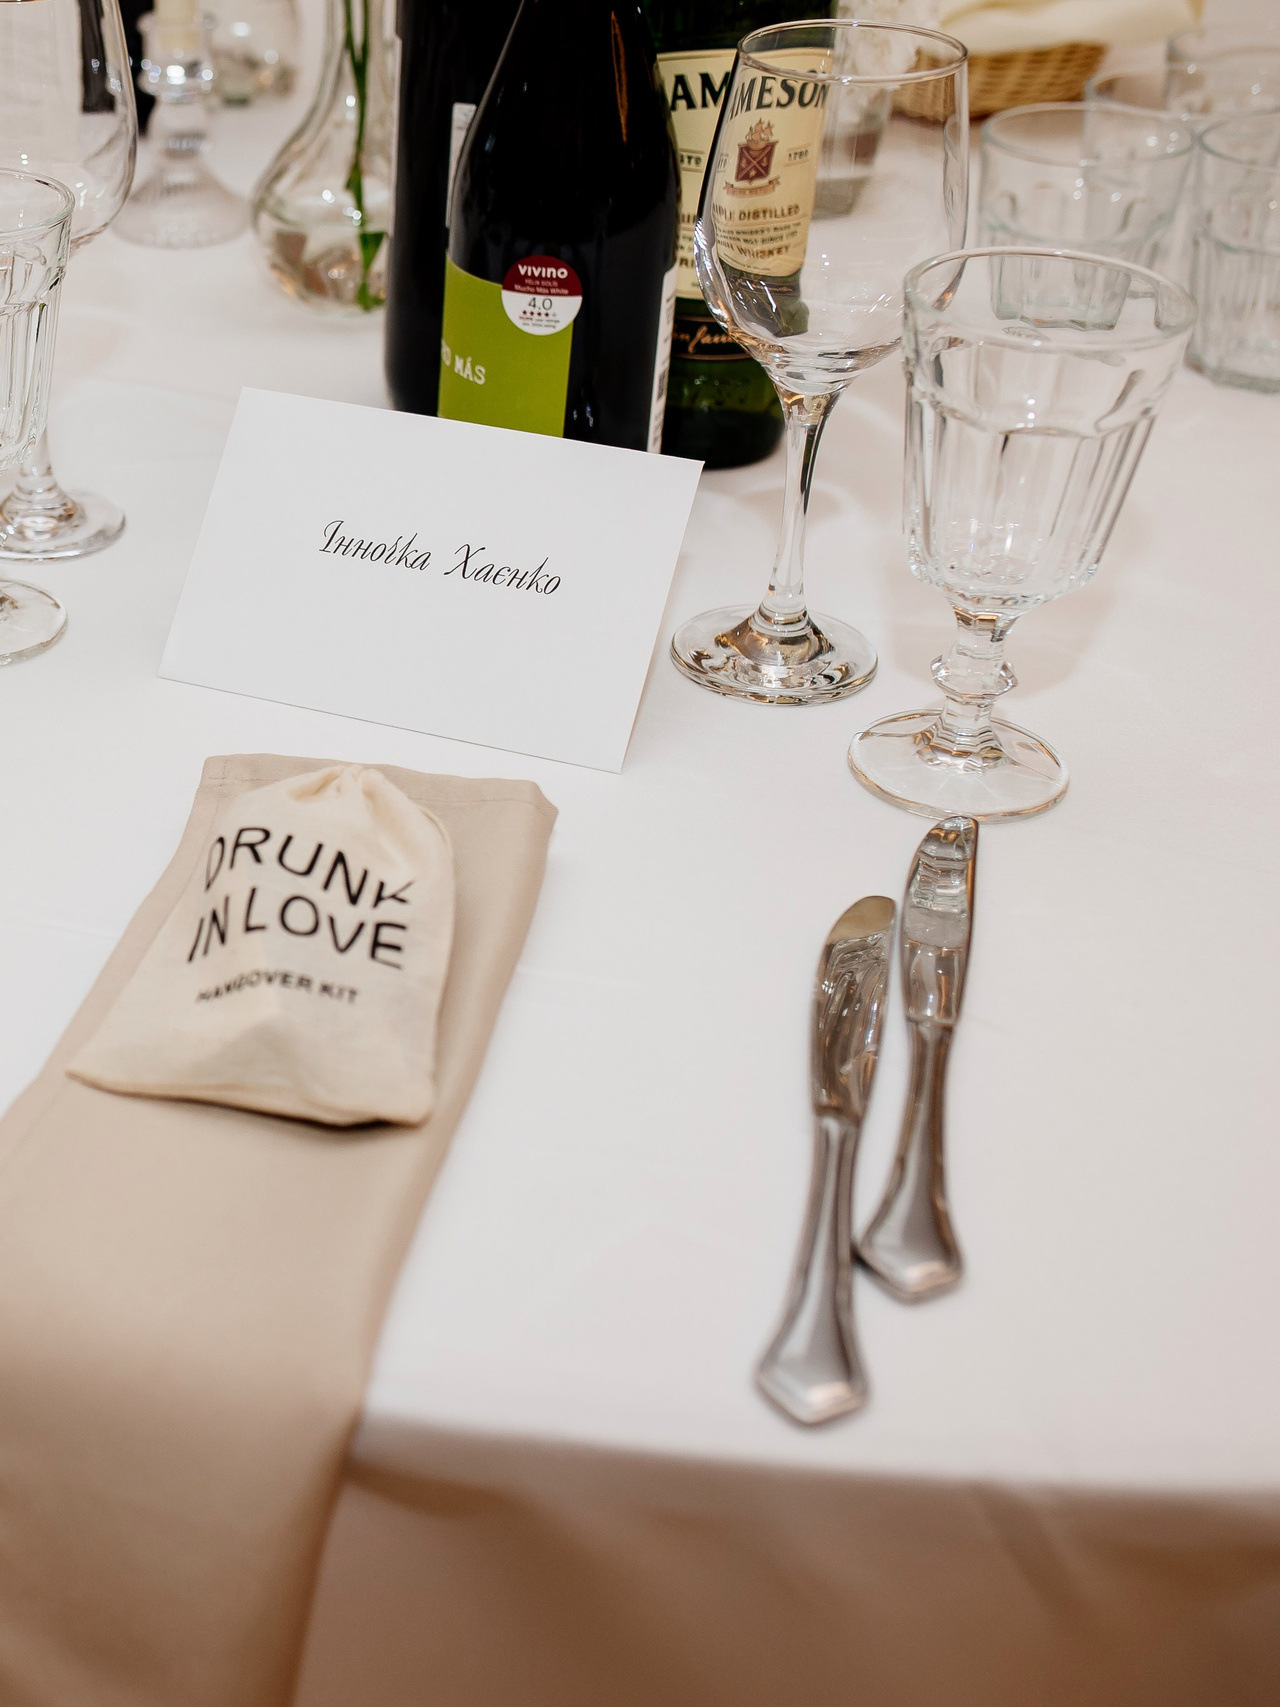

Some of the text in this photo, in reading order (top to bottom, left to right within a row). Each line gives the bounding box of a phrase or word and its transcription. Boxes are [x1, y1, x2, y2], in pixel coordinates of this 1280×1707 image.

[204, 826, 416, 910] DRUNK
[187, 886, 409, 970] IN LOVE
